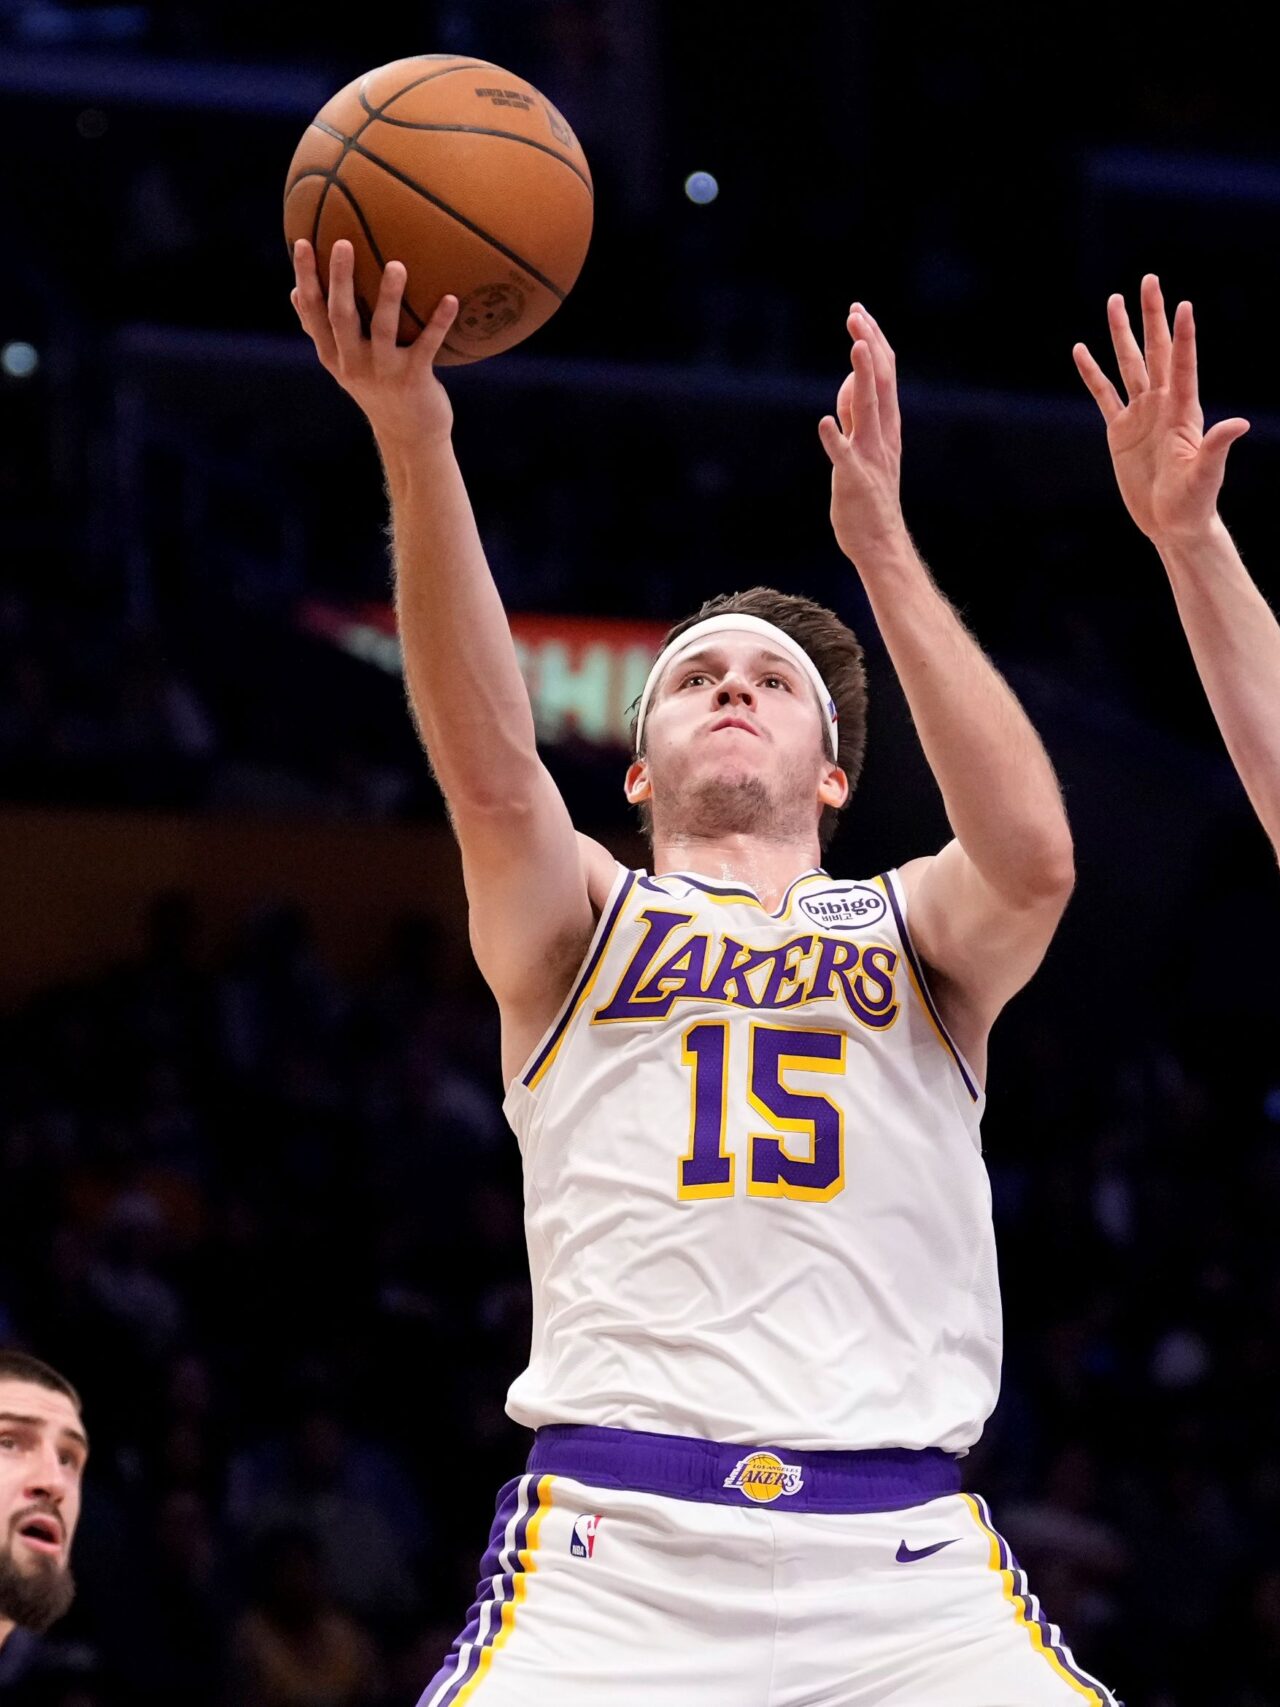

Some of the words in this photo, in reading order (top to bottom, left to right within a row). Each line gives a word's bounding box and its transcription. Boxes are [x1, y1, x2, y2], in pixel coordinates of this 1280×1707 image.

[805, 898, 880, 916] bibigo
[822, 913, 854, 922] 비비고
[590, 908, 900, 1031] LAKERS
[677, 1020, 847, 1203] 15
[730, 1463, 800, 1493] LAKERS
[767, 1464, 799, 1473] ANGELES
